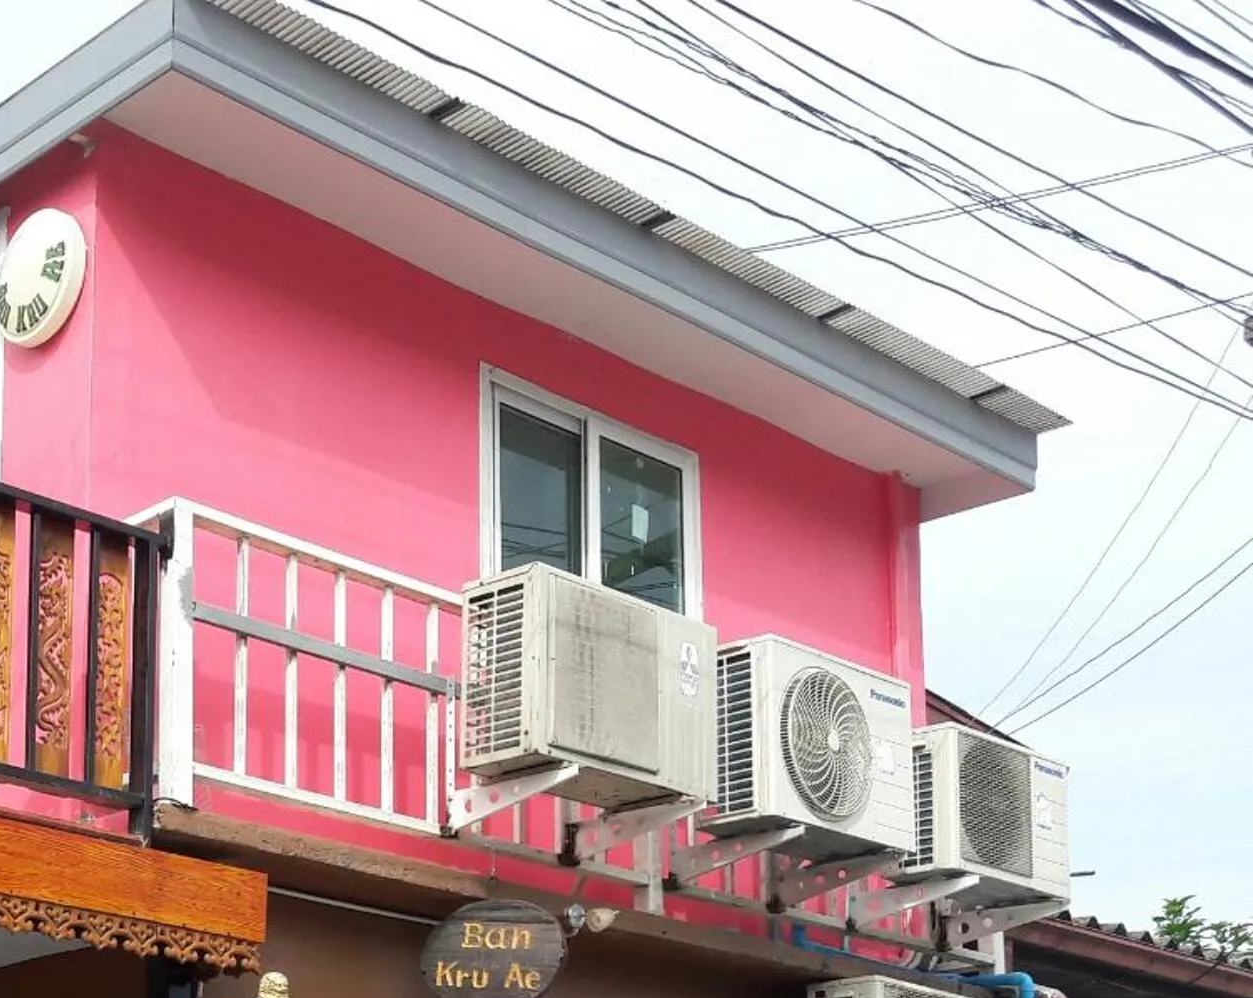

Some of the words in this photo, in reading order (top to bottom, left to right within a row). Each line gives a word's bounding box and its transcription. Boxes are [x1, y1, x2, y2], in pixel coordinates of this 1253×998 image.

[16, 294, 49, 333] KRU
[461, 921, 532, 950] Ban
[435, 960, 491, 989] Kru
[503, 962, 542, 991] Ae
